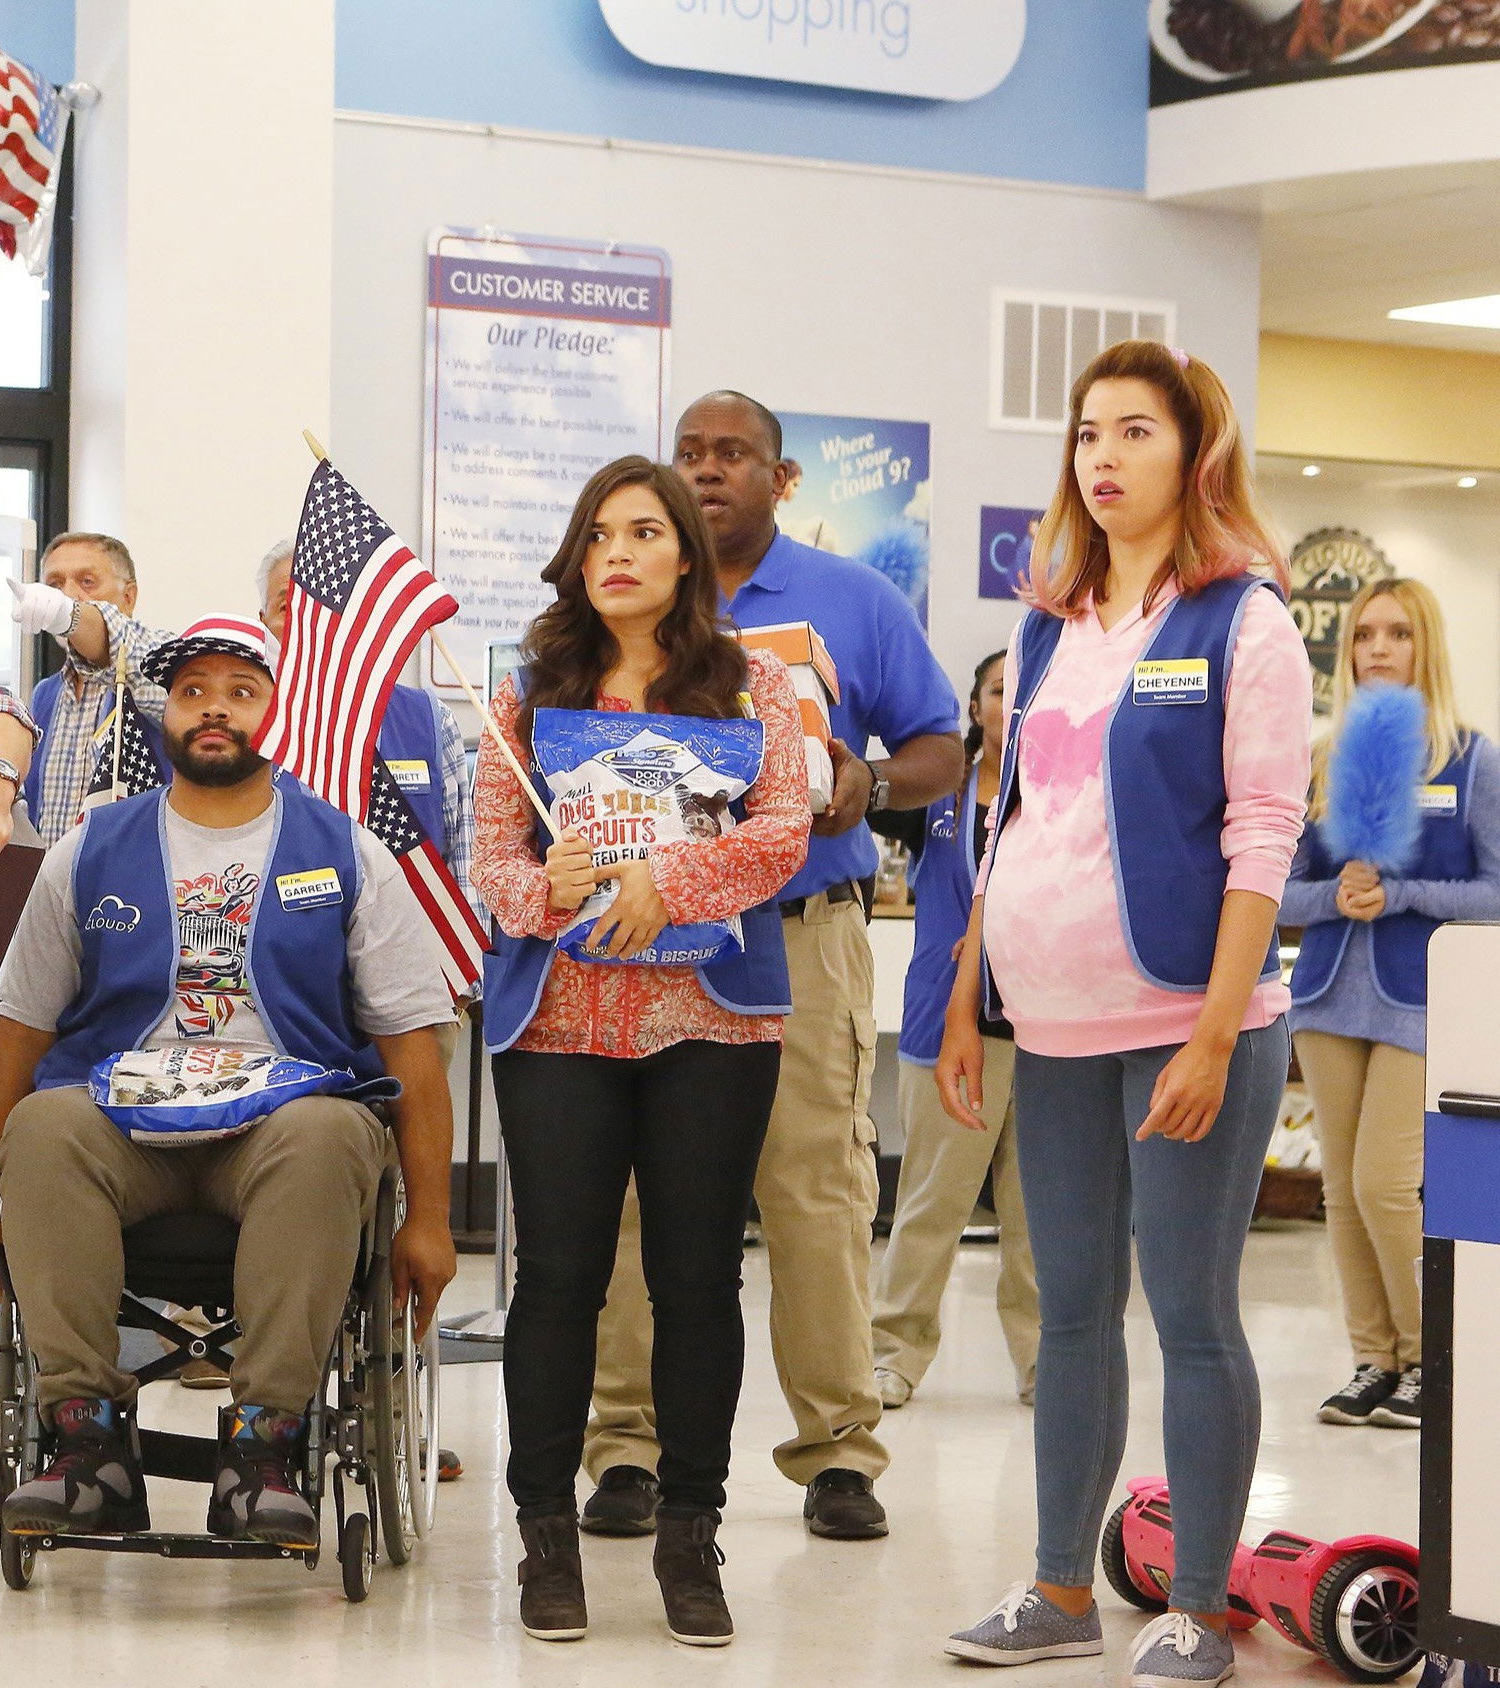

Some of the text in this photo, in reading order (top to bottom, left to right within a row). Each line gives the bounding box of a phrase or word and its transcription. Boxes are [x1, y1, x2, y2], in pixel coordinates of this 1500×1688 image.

[676, 0, 909, 58] opping
[450, 270, 650, 312] CUSTOMER SERVICE
[487, 322, 616, 357] Our Pledge:
[491, 380, 548, 395] experience
[820, 433, 875, 463] Where
[856, 447, 892, 474] your
[831, 456, 912, 503] Cloud 9?
[1138, 676, 1204, 689] CHEYENNE
[632, 779, 665, 787] FOOD
[636, 771, 661, 780] DOG
[558, 795, 596, 831] DOG
[284, 881, 336, 898] GARRETT
[84, 917, 136, 933] CLOUD9
